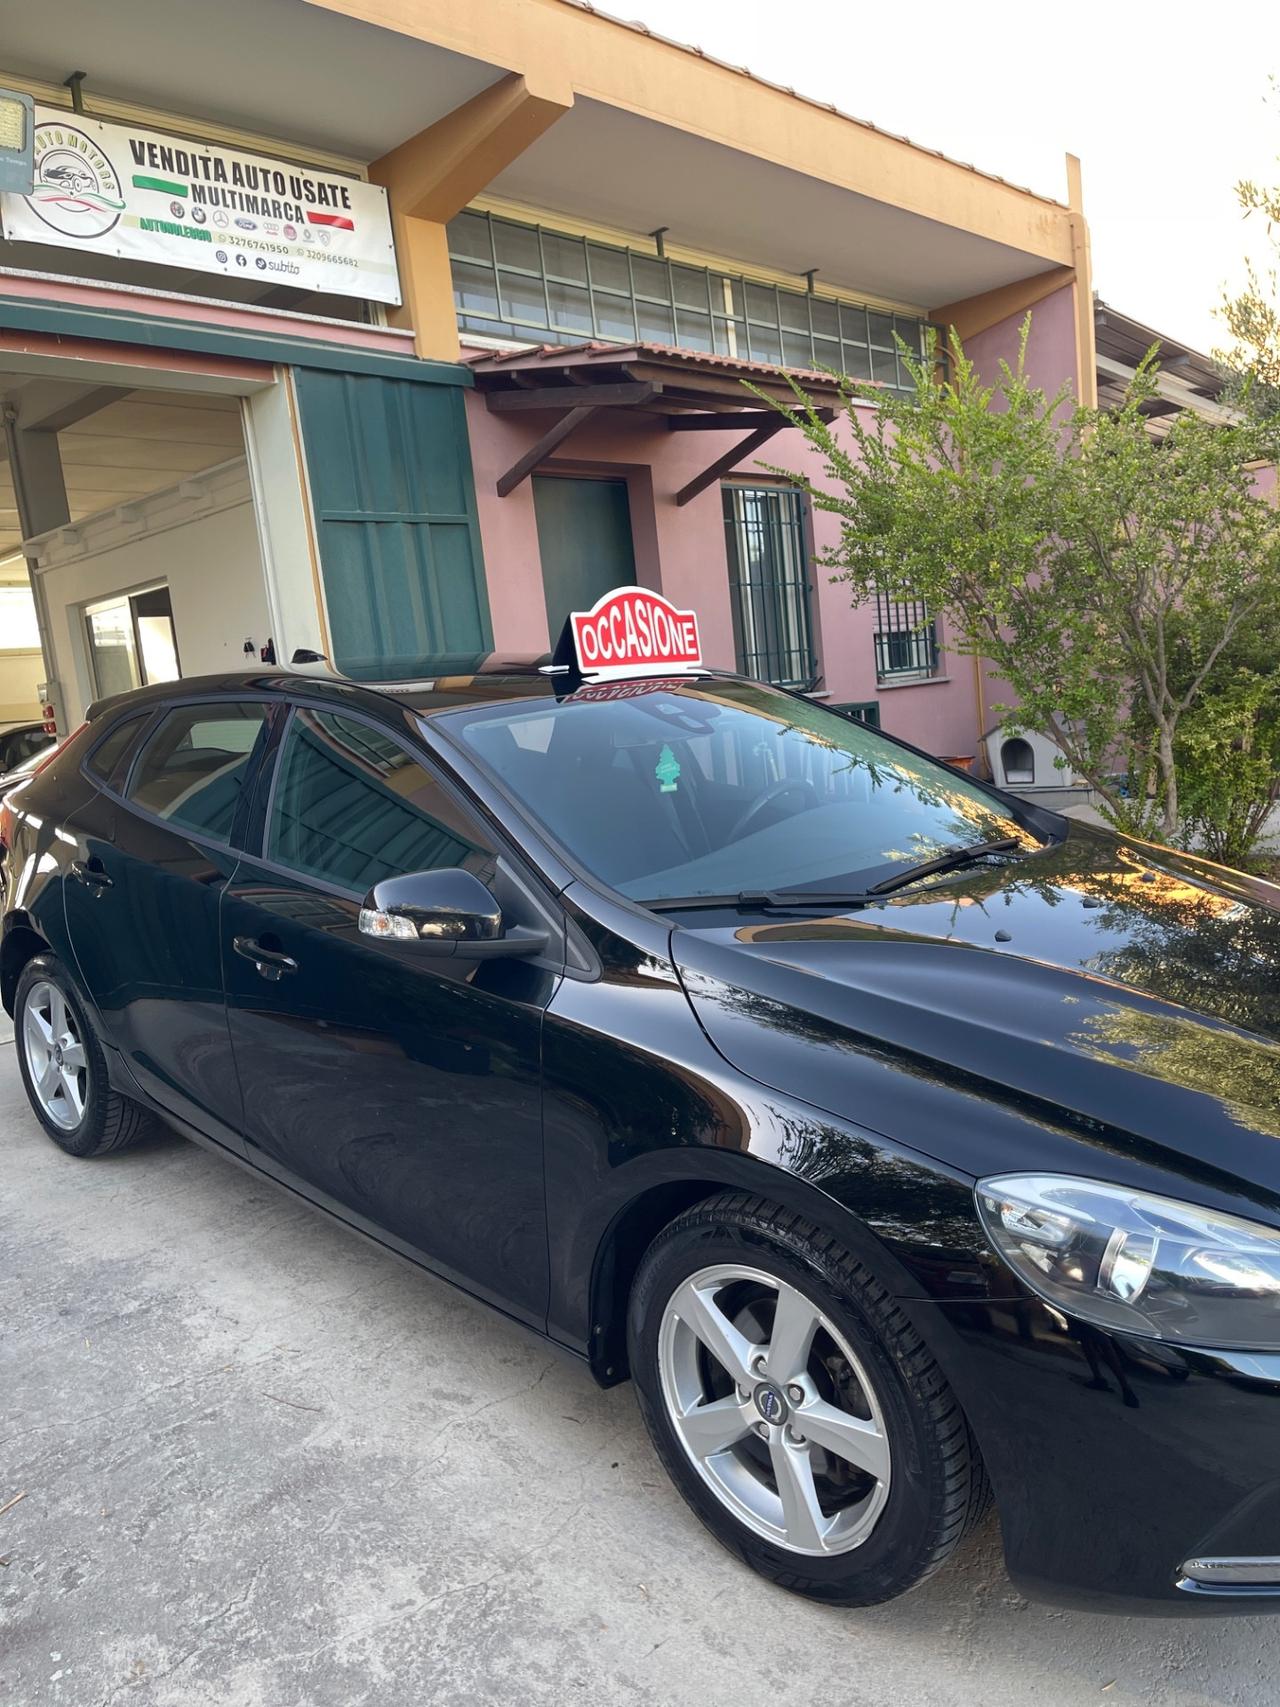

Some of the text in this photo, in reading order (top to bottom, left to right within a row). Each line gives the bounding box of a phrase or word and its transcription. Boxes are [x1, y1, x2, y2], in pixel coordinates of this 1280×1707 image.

[129, 139, 352, 210] VENDITA AUTO USATE
[191, 183, 305, 224] MULTIMARCA
[140, 217, 212, 242] AUTONOLEGGIO
[229, 236, 289, 254] 3276741950
[268, 260, 300, 275] subito
[306, 250, 359, 267] 3209665682
[582, 599, 697, 660] OCCASIONE
